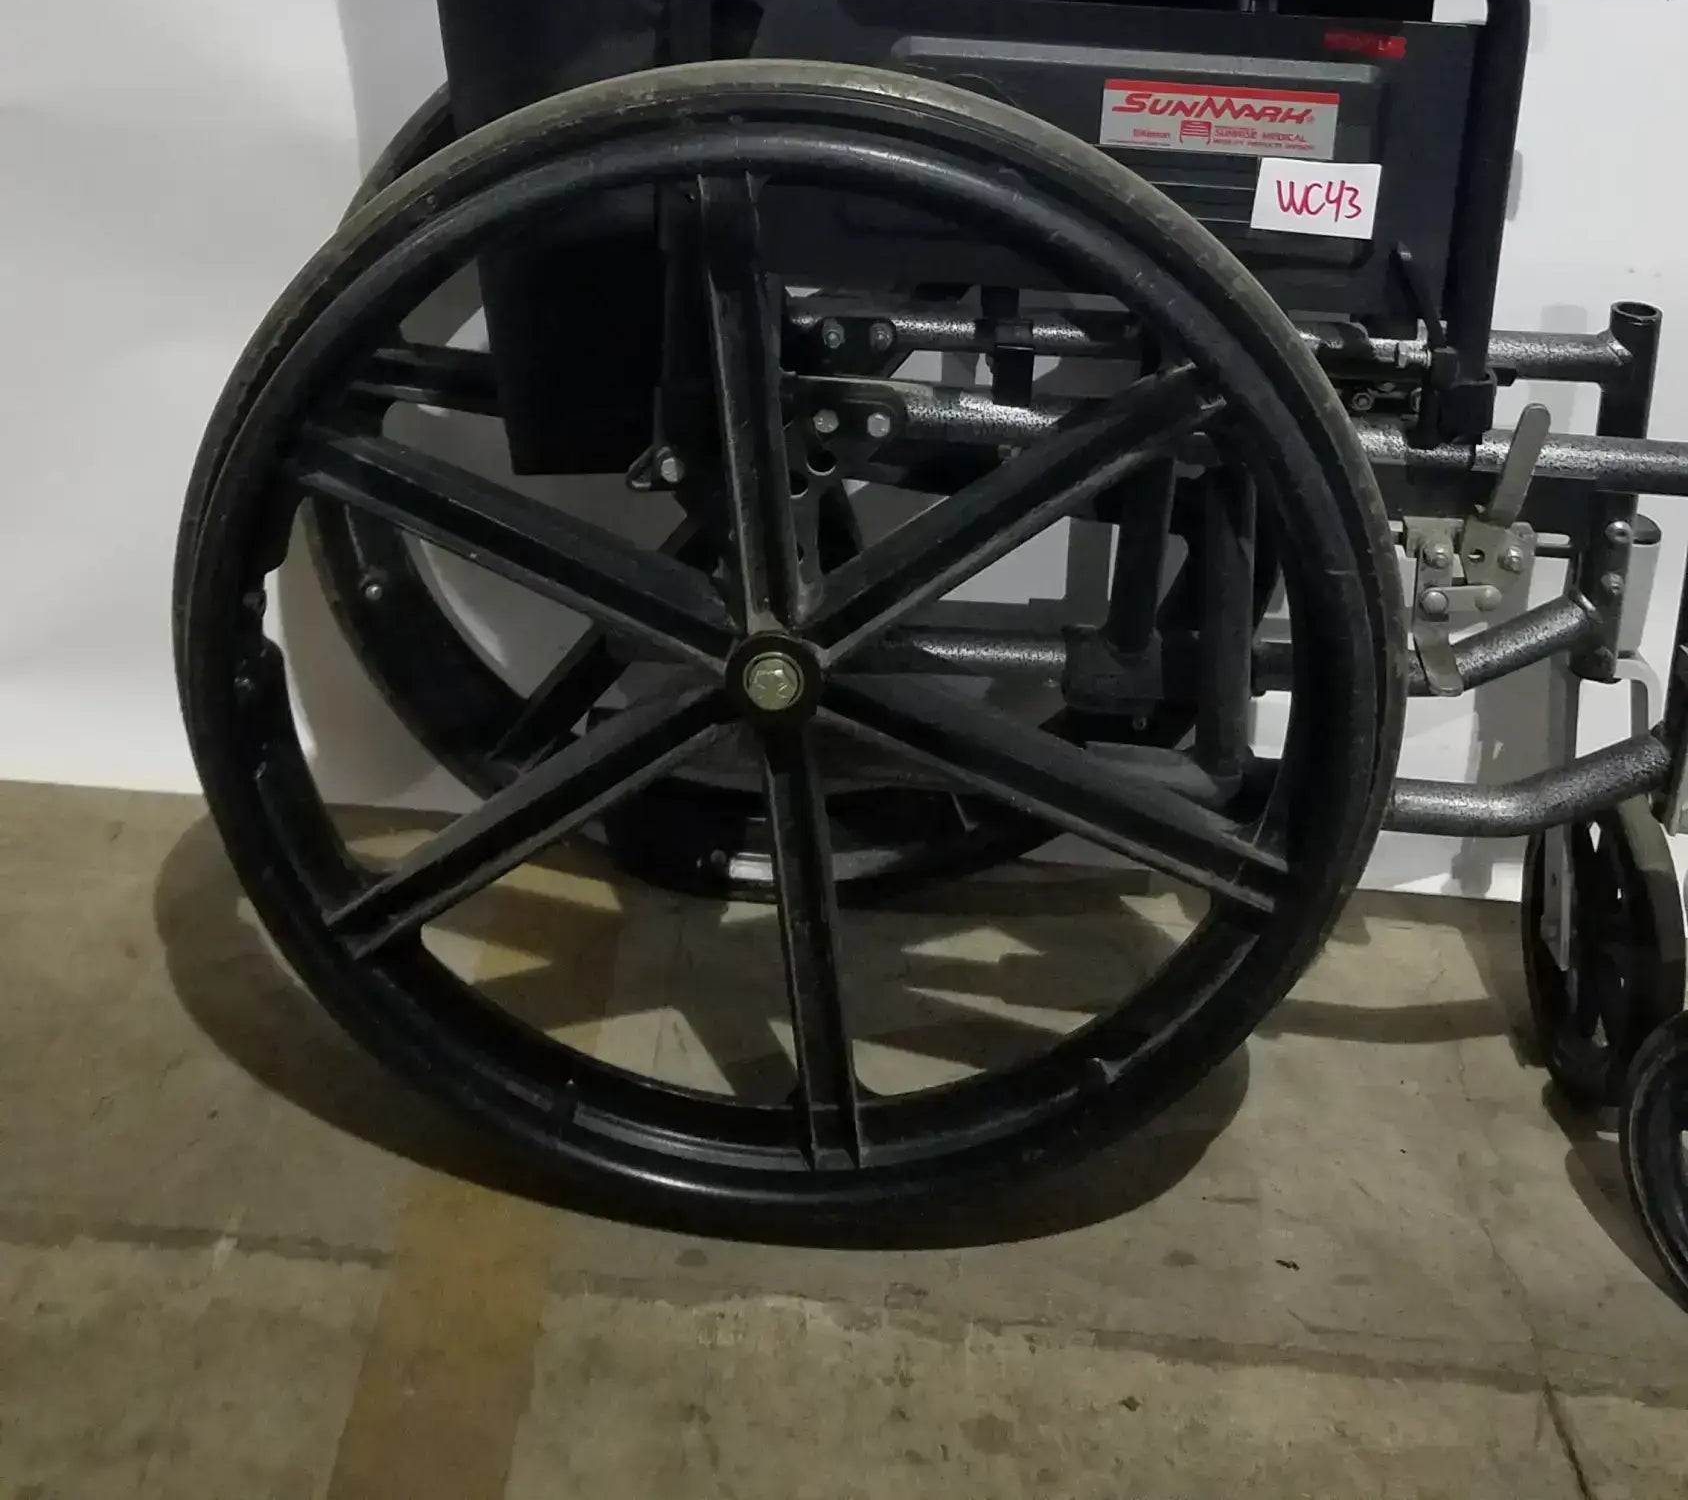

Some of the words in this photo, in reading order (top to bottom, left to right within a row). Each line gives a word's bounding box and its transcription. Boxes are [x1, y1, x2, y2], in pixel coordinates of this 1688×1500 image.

[1214, 128, 1257, 139] SUNRISE
[1262, 132, 1306, 143] MEDICAL
[1276, 180, 1361, 222] WC43
